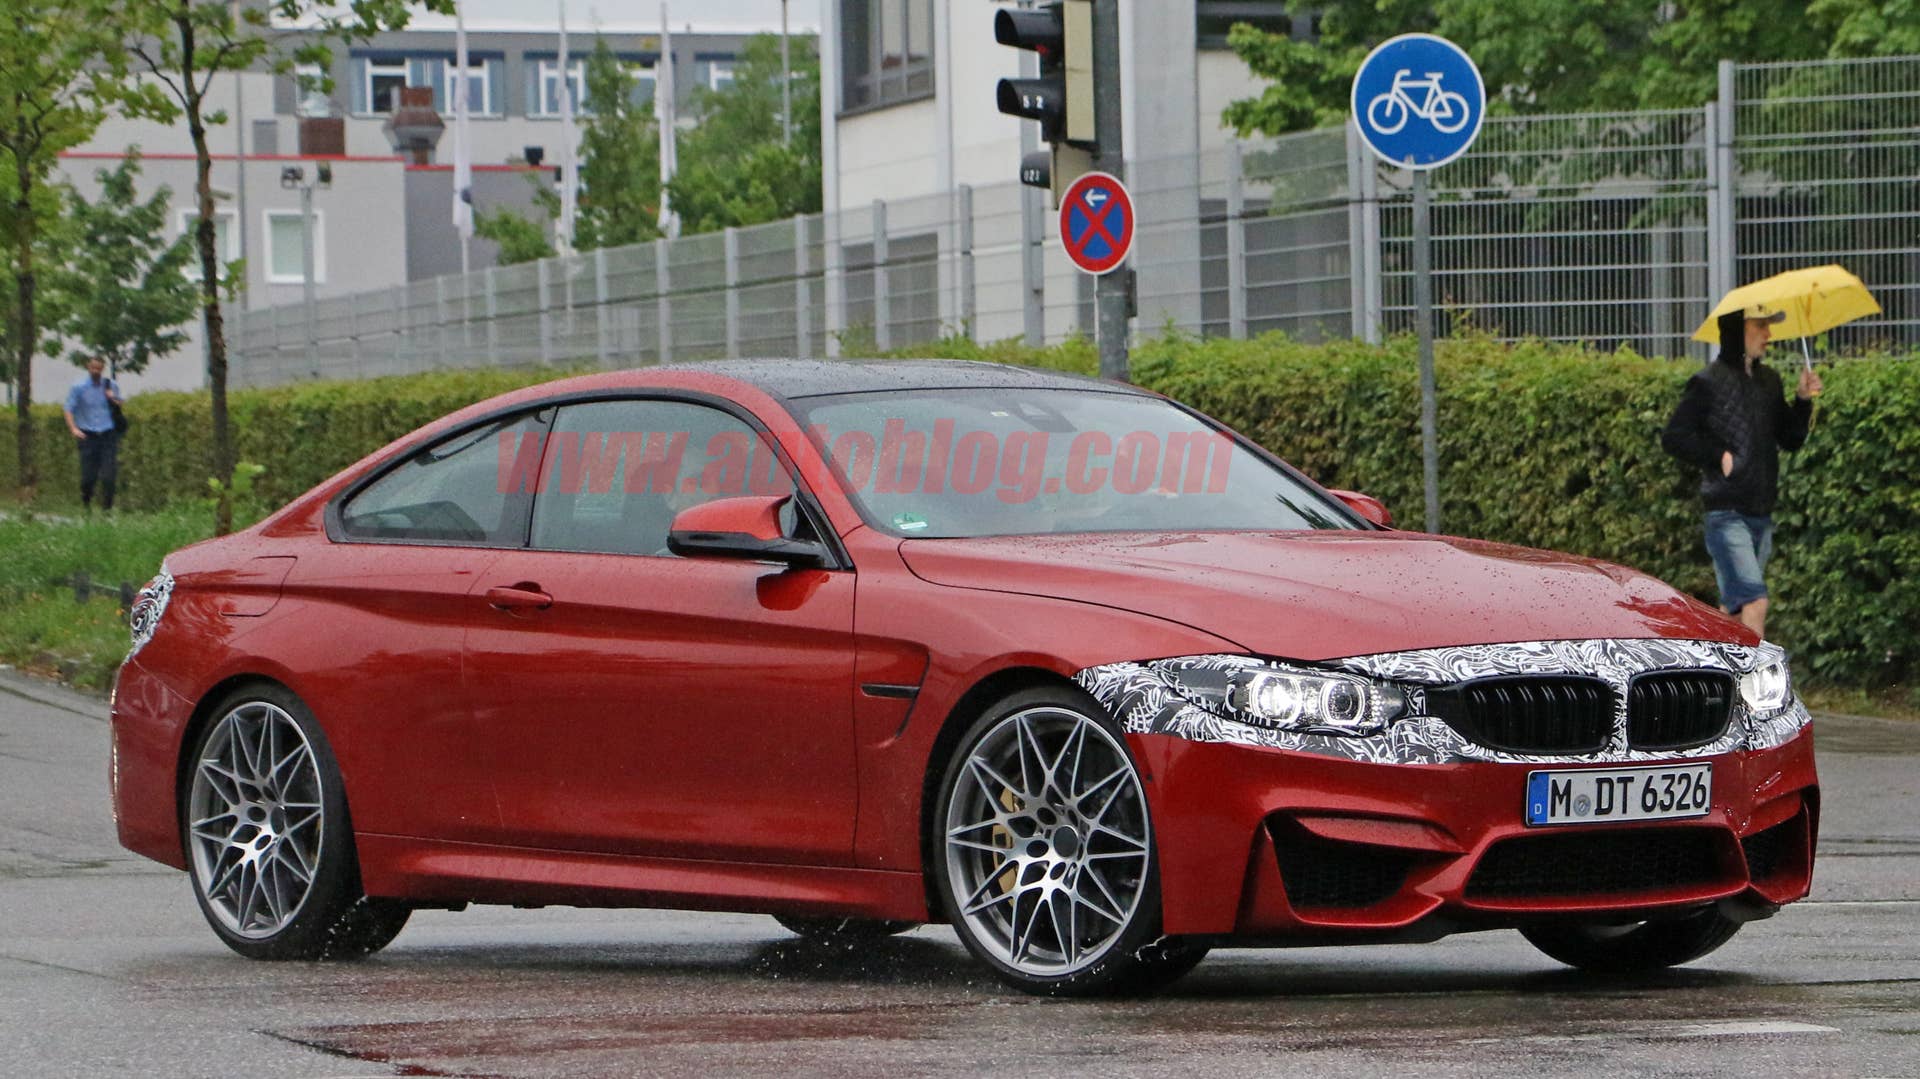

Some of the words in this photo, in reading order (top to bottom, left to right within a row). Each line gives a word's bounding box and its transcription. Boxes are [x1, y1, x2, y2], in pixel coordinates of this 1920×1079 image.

[1534, 803, 1542, 815] D
[1550, 779, 1572, 818] M
[1594, 776, 1635, 816] DT
[1641, 772, 1707, 813] 6326
